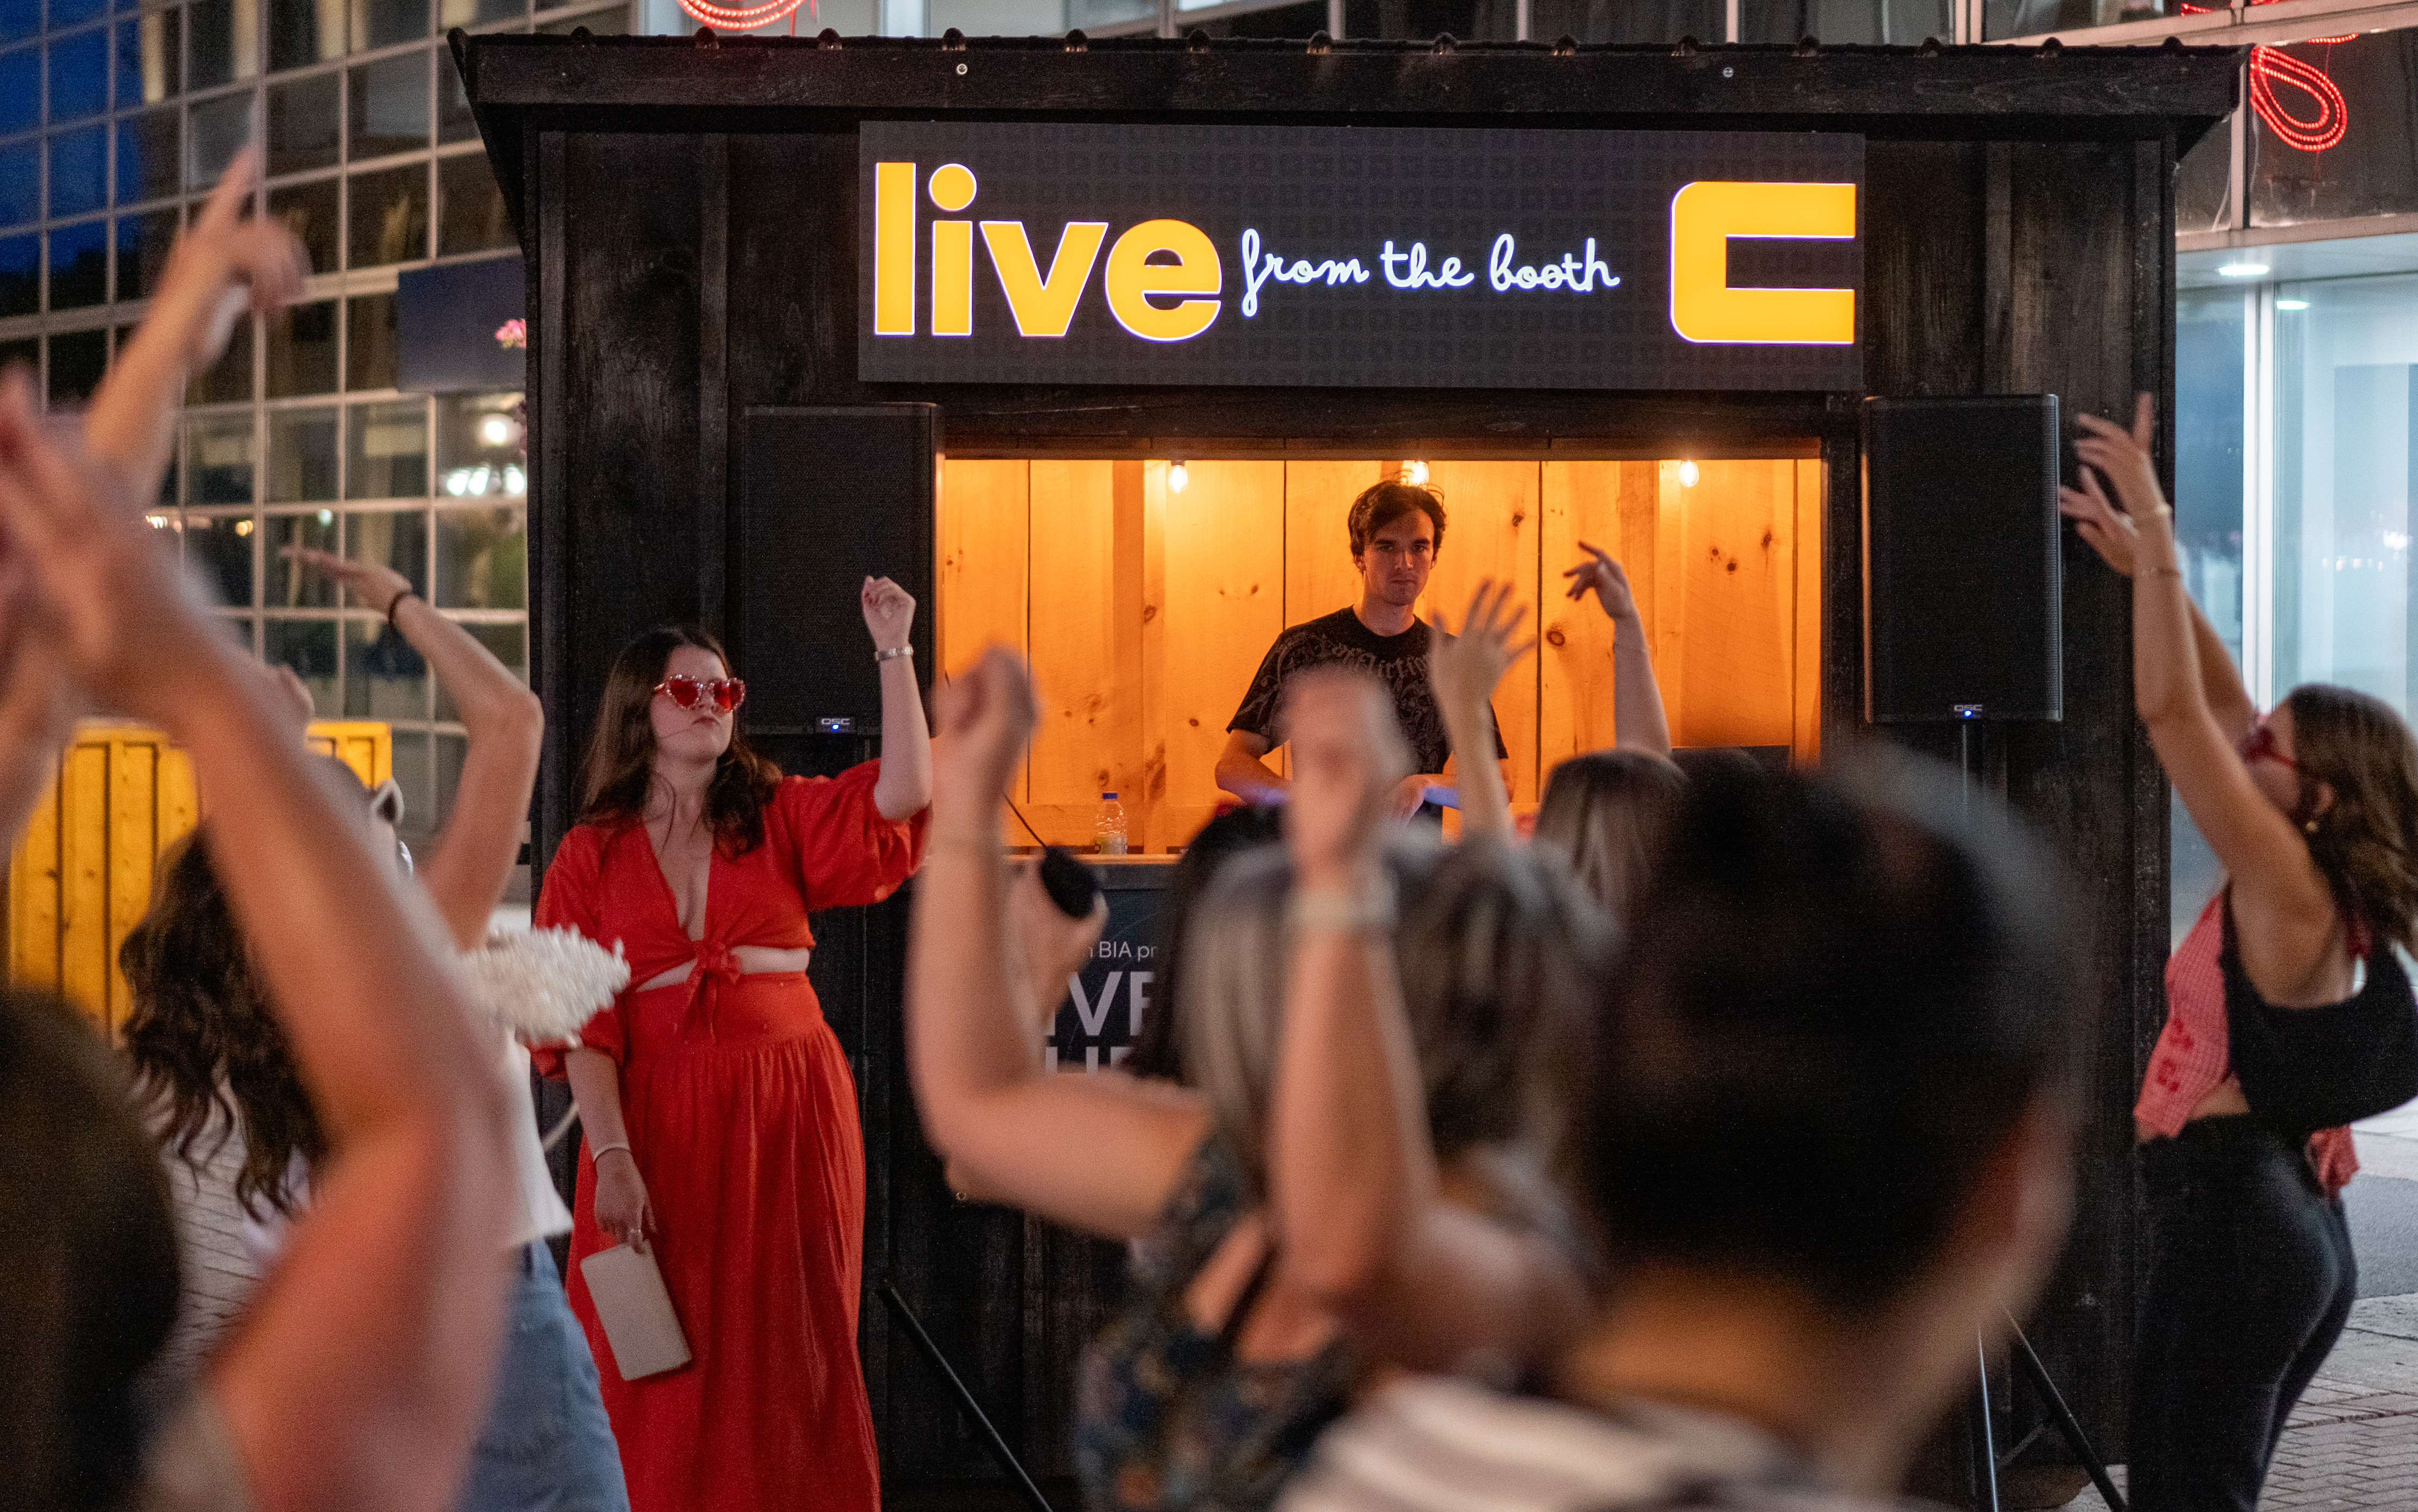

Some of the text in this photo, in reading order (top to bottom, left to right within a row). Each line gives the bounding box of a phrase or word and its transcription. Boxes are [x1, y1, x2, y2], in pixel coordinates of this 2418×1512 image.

[873, 162, 1620, 343] live from the booth
[1099, 941, 1132, 958] BIA
